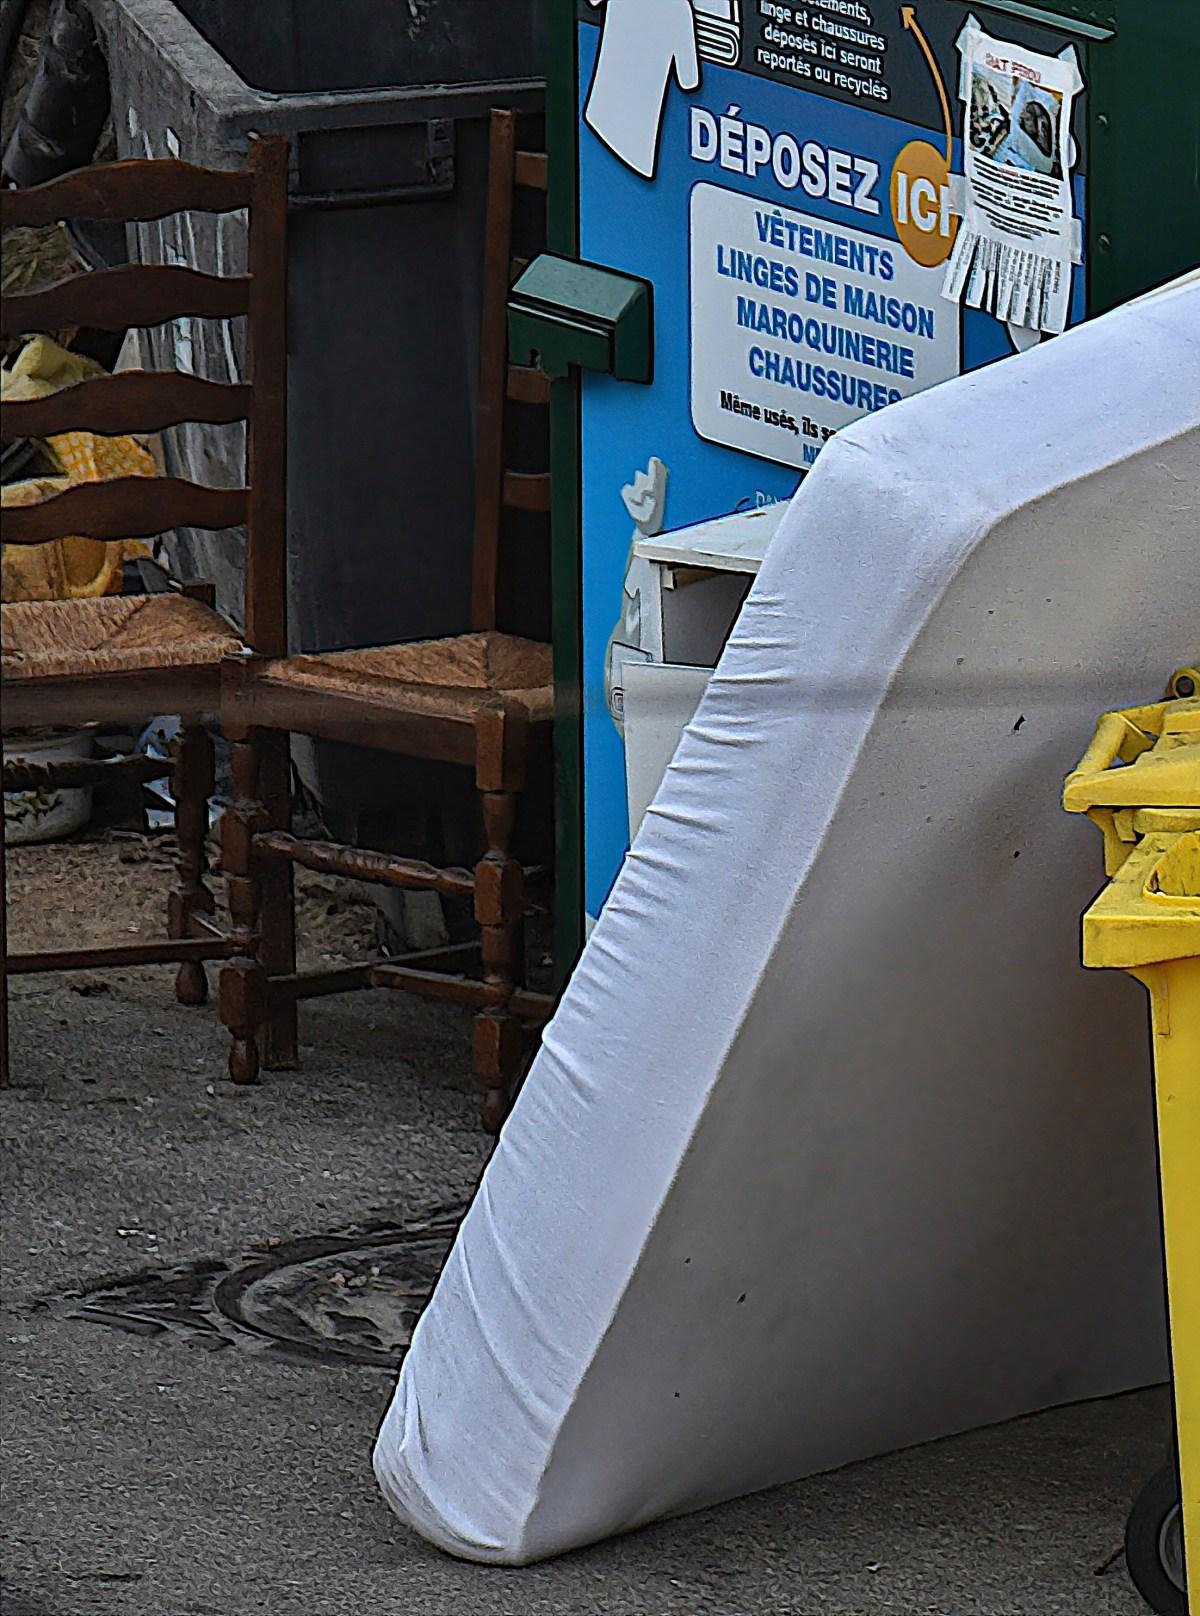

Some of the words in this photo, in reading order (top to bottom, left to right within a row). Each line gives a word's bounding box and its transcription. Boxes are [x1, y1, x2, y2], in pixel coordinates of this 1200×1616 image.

[764, 23, 817, 54] déposés
[821, 39, 837, 60] ici
[840, 49, 882, 74] seront
[795, 10, 809, 27] et
[812, 15, 885, 51] chaussures
[757, 49, 811, 77] reportés
[815, 66, 831, 83] ou
[834, 72, 888, 100] recyclés
[690, 104, 880, 215] DÉPOSEZ
[755, 209, 894, 281] VÊTEMENTS
[717, 244, 799, 297] LINGES
[805, 271, 837, 310] DE
[843, 283, 935, 340] MAISON
[736, 295, 915, 379] MAROQUINERIE
[720, 390, 761, 421] Même
[764, 409, 799, 436] usés,
